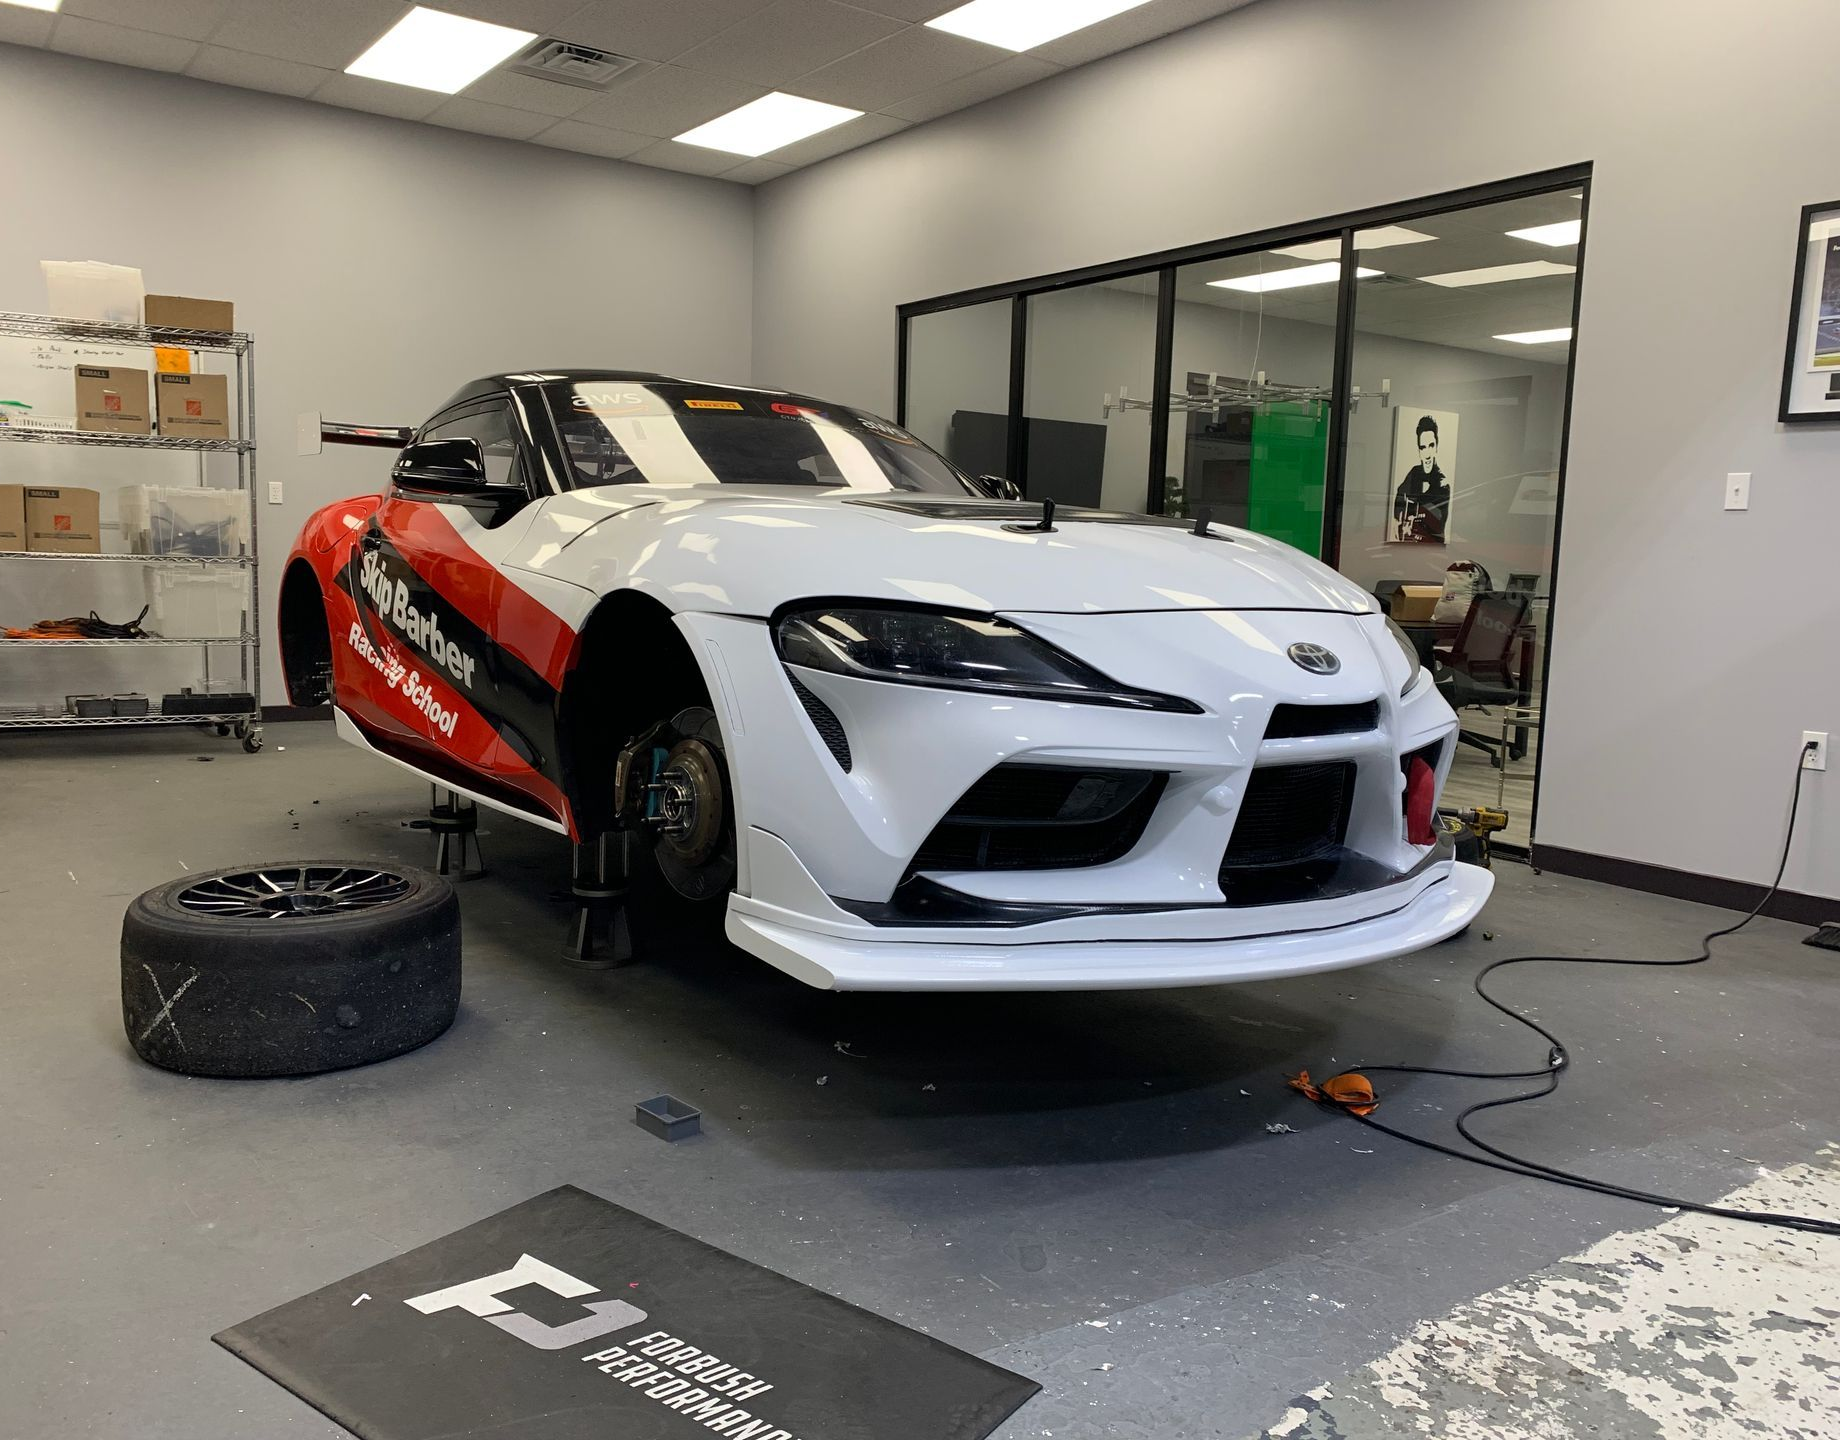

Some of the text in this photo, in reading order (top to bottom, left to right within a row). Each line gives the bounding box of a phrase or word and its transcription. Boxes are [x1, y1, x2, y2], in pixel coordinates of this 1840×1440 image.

[571, 393, 642, 406] aws
[360, 550, 475, 690] Skip Barber
[402, 670, 458, 738] School
[626, 1331, 774, 1401] FORBUSH
